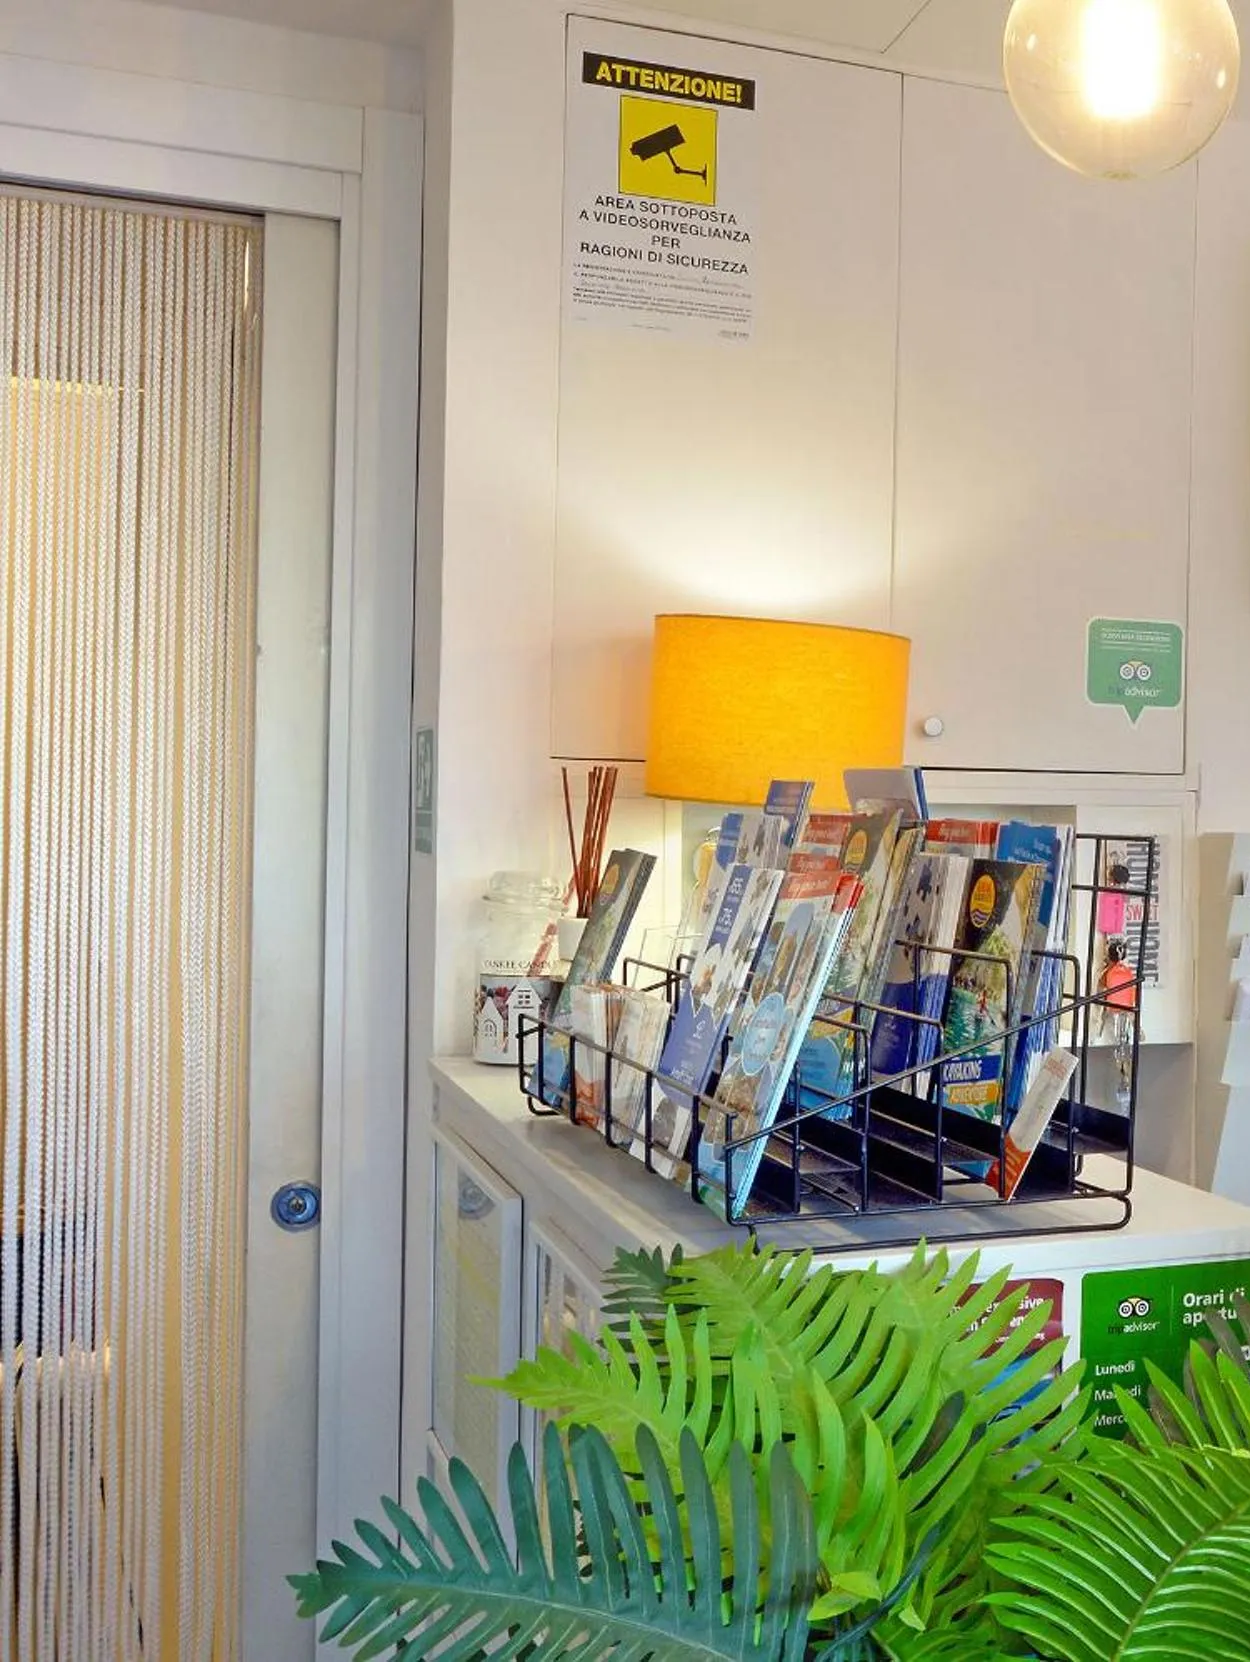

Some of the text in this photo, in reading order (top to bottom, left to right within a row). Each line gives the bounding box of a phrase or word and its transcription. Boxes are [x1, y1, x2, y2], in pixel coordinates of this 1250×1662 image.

[595, 61, 743, 104] ATTENZIONE!
[594, 195, 737, 226] AREA SOTTOPOSTA
[579, 210, 751, 244] A VIDEOSORVEGLIANZA
[651, 234, 681, 250] PER
[580, 242, 643, 262] RAGIONI
[647, 250, 663, 264] DI
[667, 252, 749, 276] SICUREZZA
[1183, 1290, 1224, 1308] Orari
